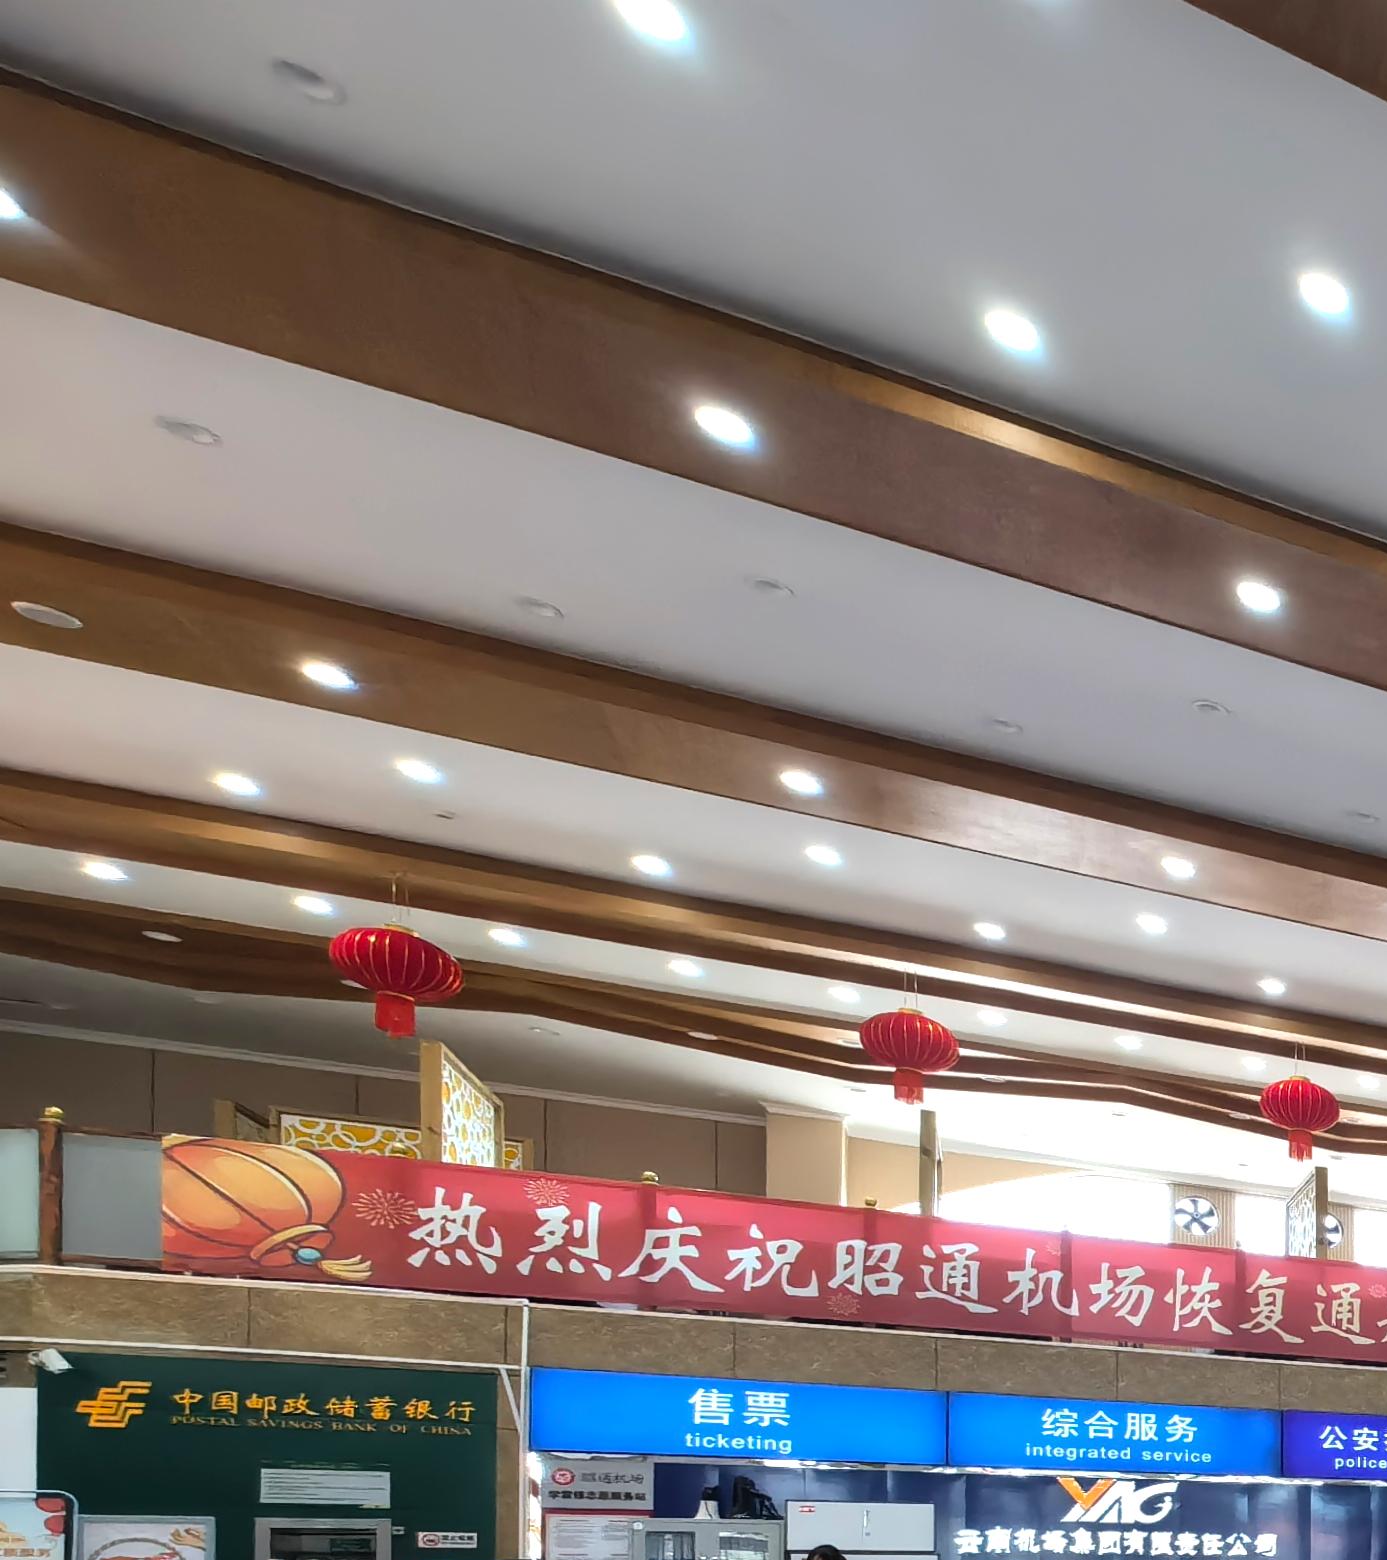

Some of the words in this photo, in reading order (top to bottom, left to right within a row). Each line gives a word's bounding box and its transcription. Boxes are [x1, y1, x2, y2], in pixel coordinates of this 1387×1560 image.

[172, 1388, 477, 1423] 中国邮政储蓄银行
[688, 1387, 791, 1427] 售票
[170, 1415, 240, 1428] POSTAL
[246, 1418, 324, 1431] SAVINGS
[331, 1421, 378, 1433] BANK
[420, 1425, 473, 1437] CHINA
[1040, 1408, 1199, 1443] 综合服务
[685, 1432, 793, 1454] ticketing
[1025, 1443, 1132, 1462] integrated
[1141, 1449, 1212, 1463] service
[952, 1526, 1279, 1557] 云南机场集团有限责任公司
